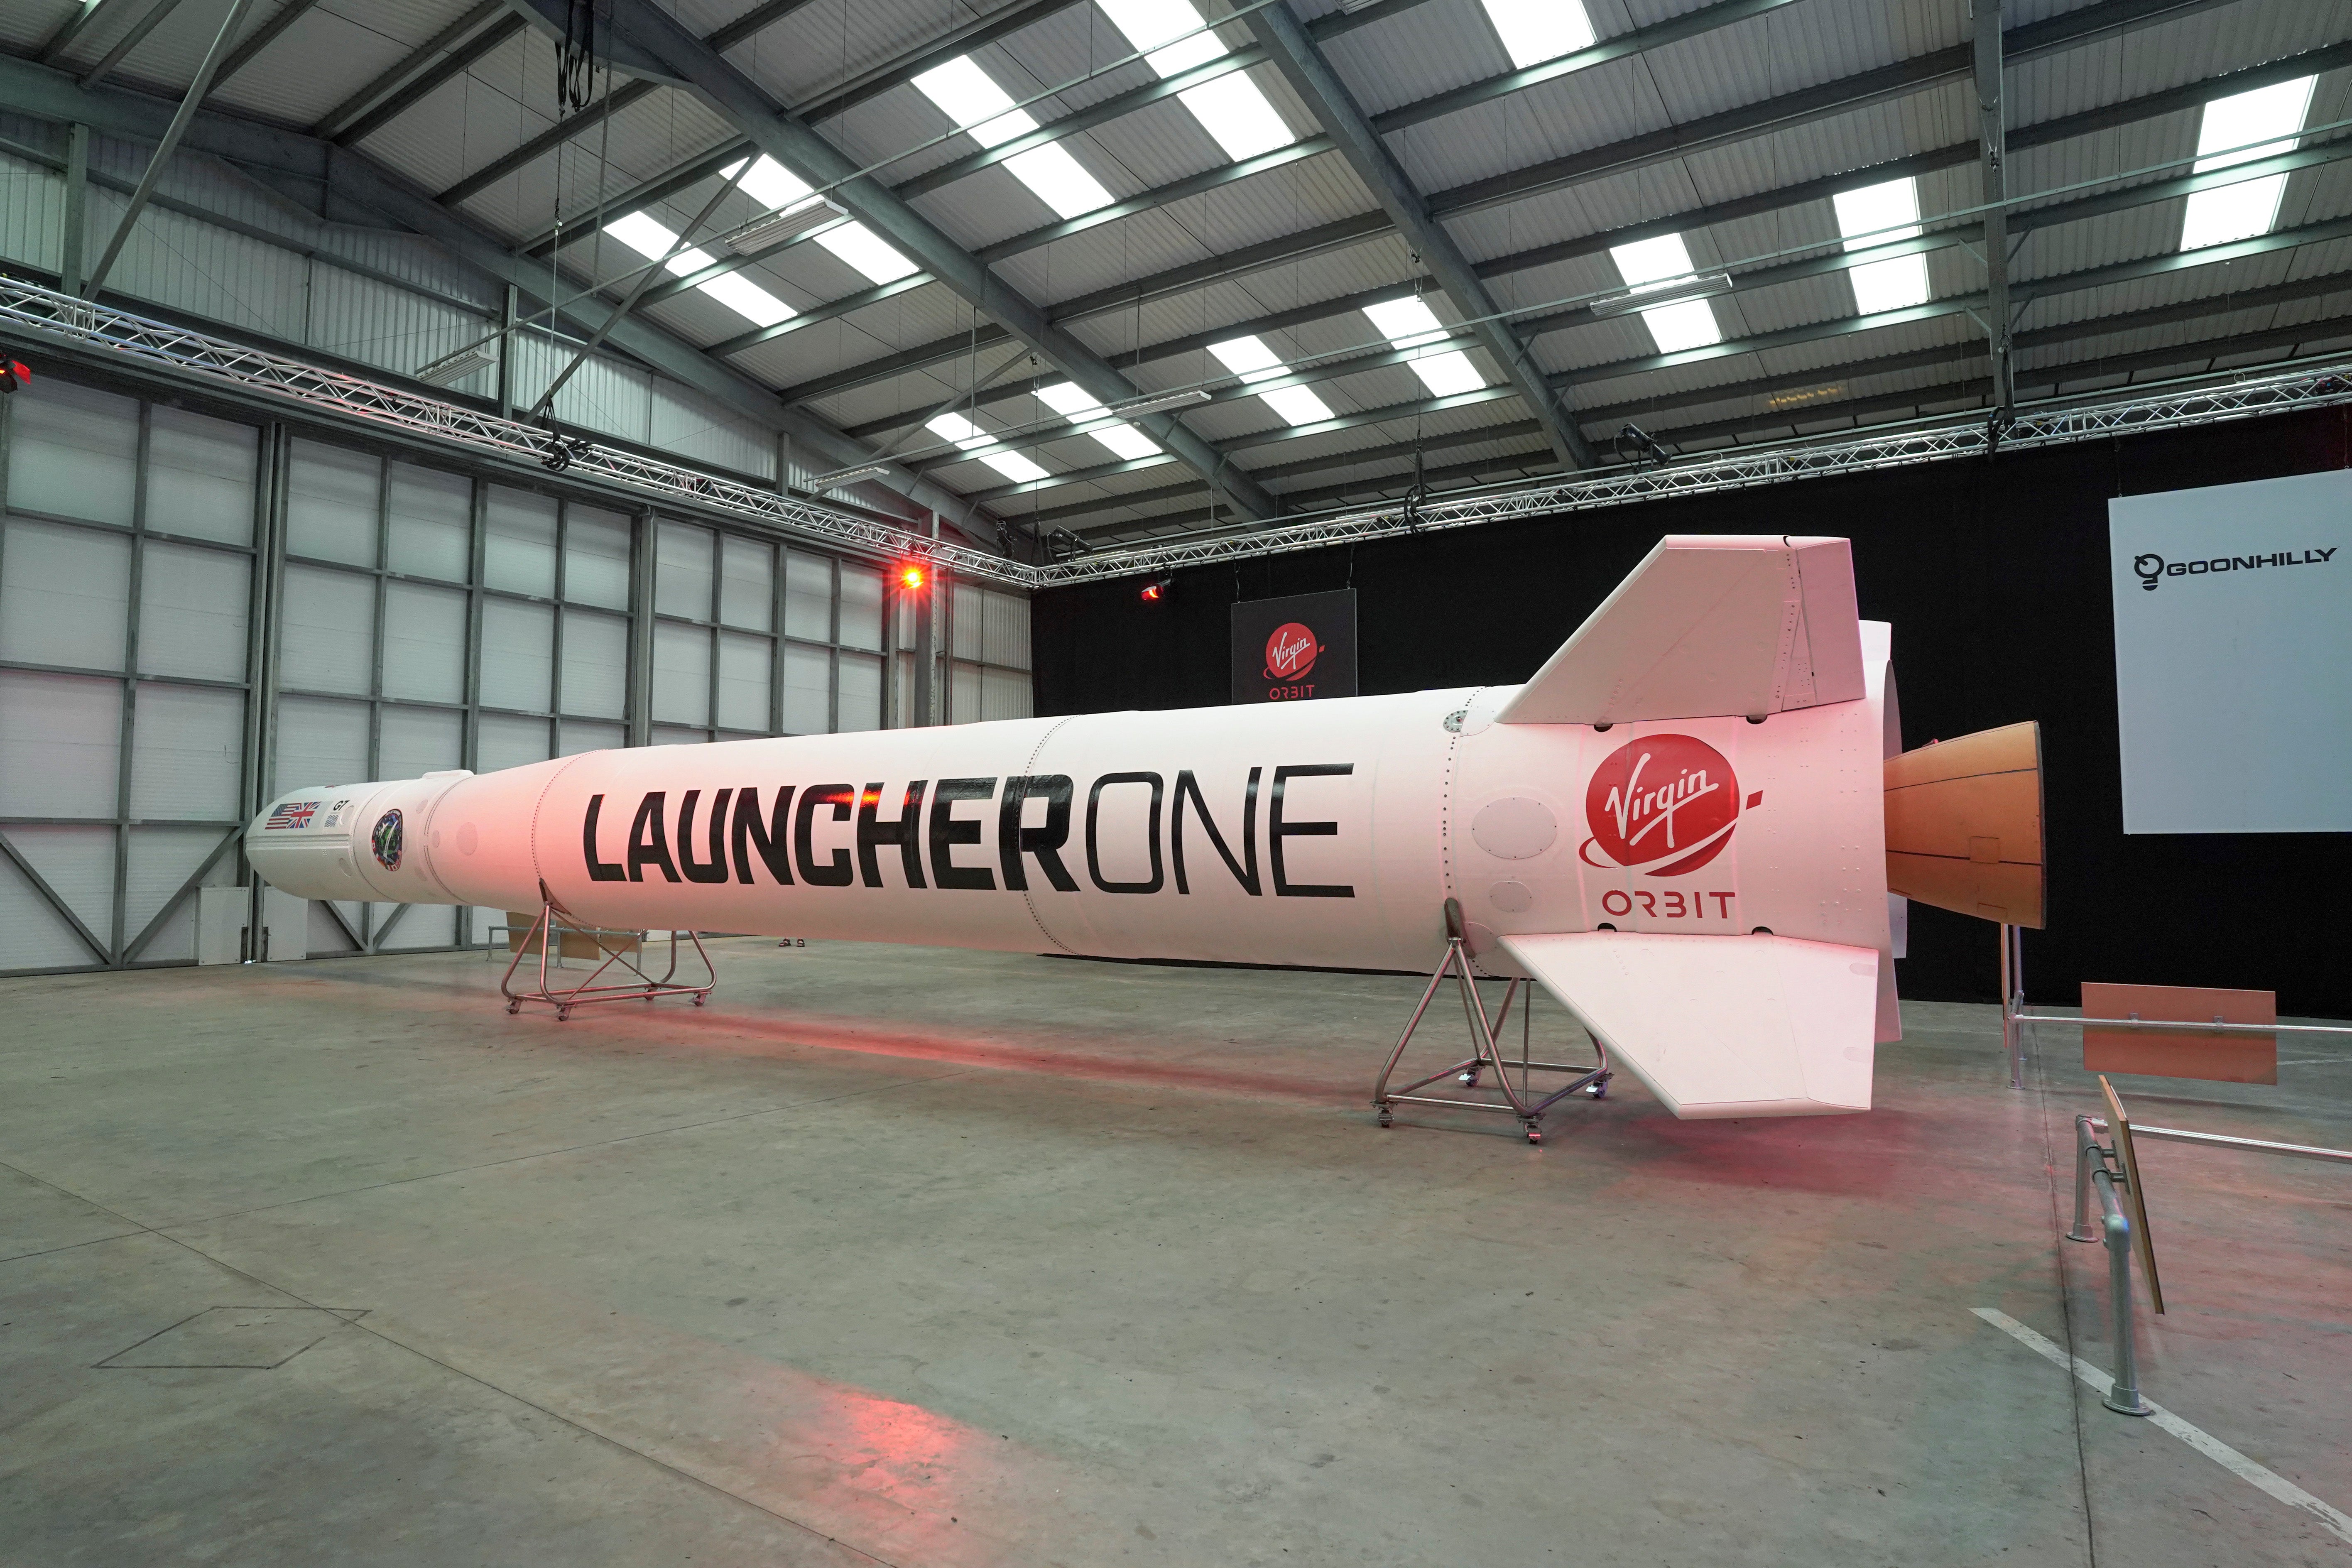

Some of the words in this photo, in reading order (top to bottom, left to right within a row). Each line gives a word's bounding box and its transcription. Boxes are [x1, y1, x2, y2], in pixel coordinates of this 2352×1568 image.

[2167, 547, 2338, 576] GOONHILLY
[1272, 632, 1311, 669] Virgin
[1269, 685, 1314, 699] ORBIT
[333, 800, 350, 811] G7
[1605, 752, 1719, 848] Virgin
[1602, 890, 1736, 919] ORBIT
